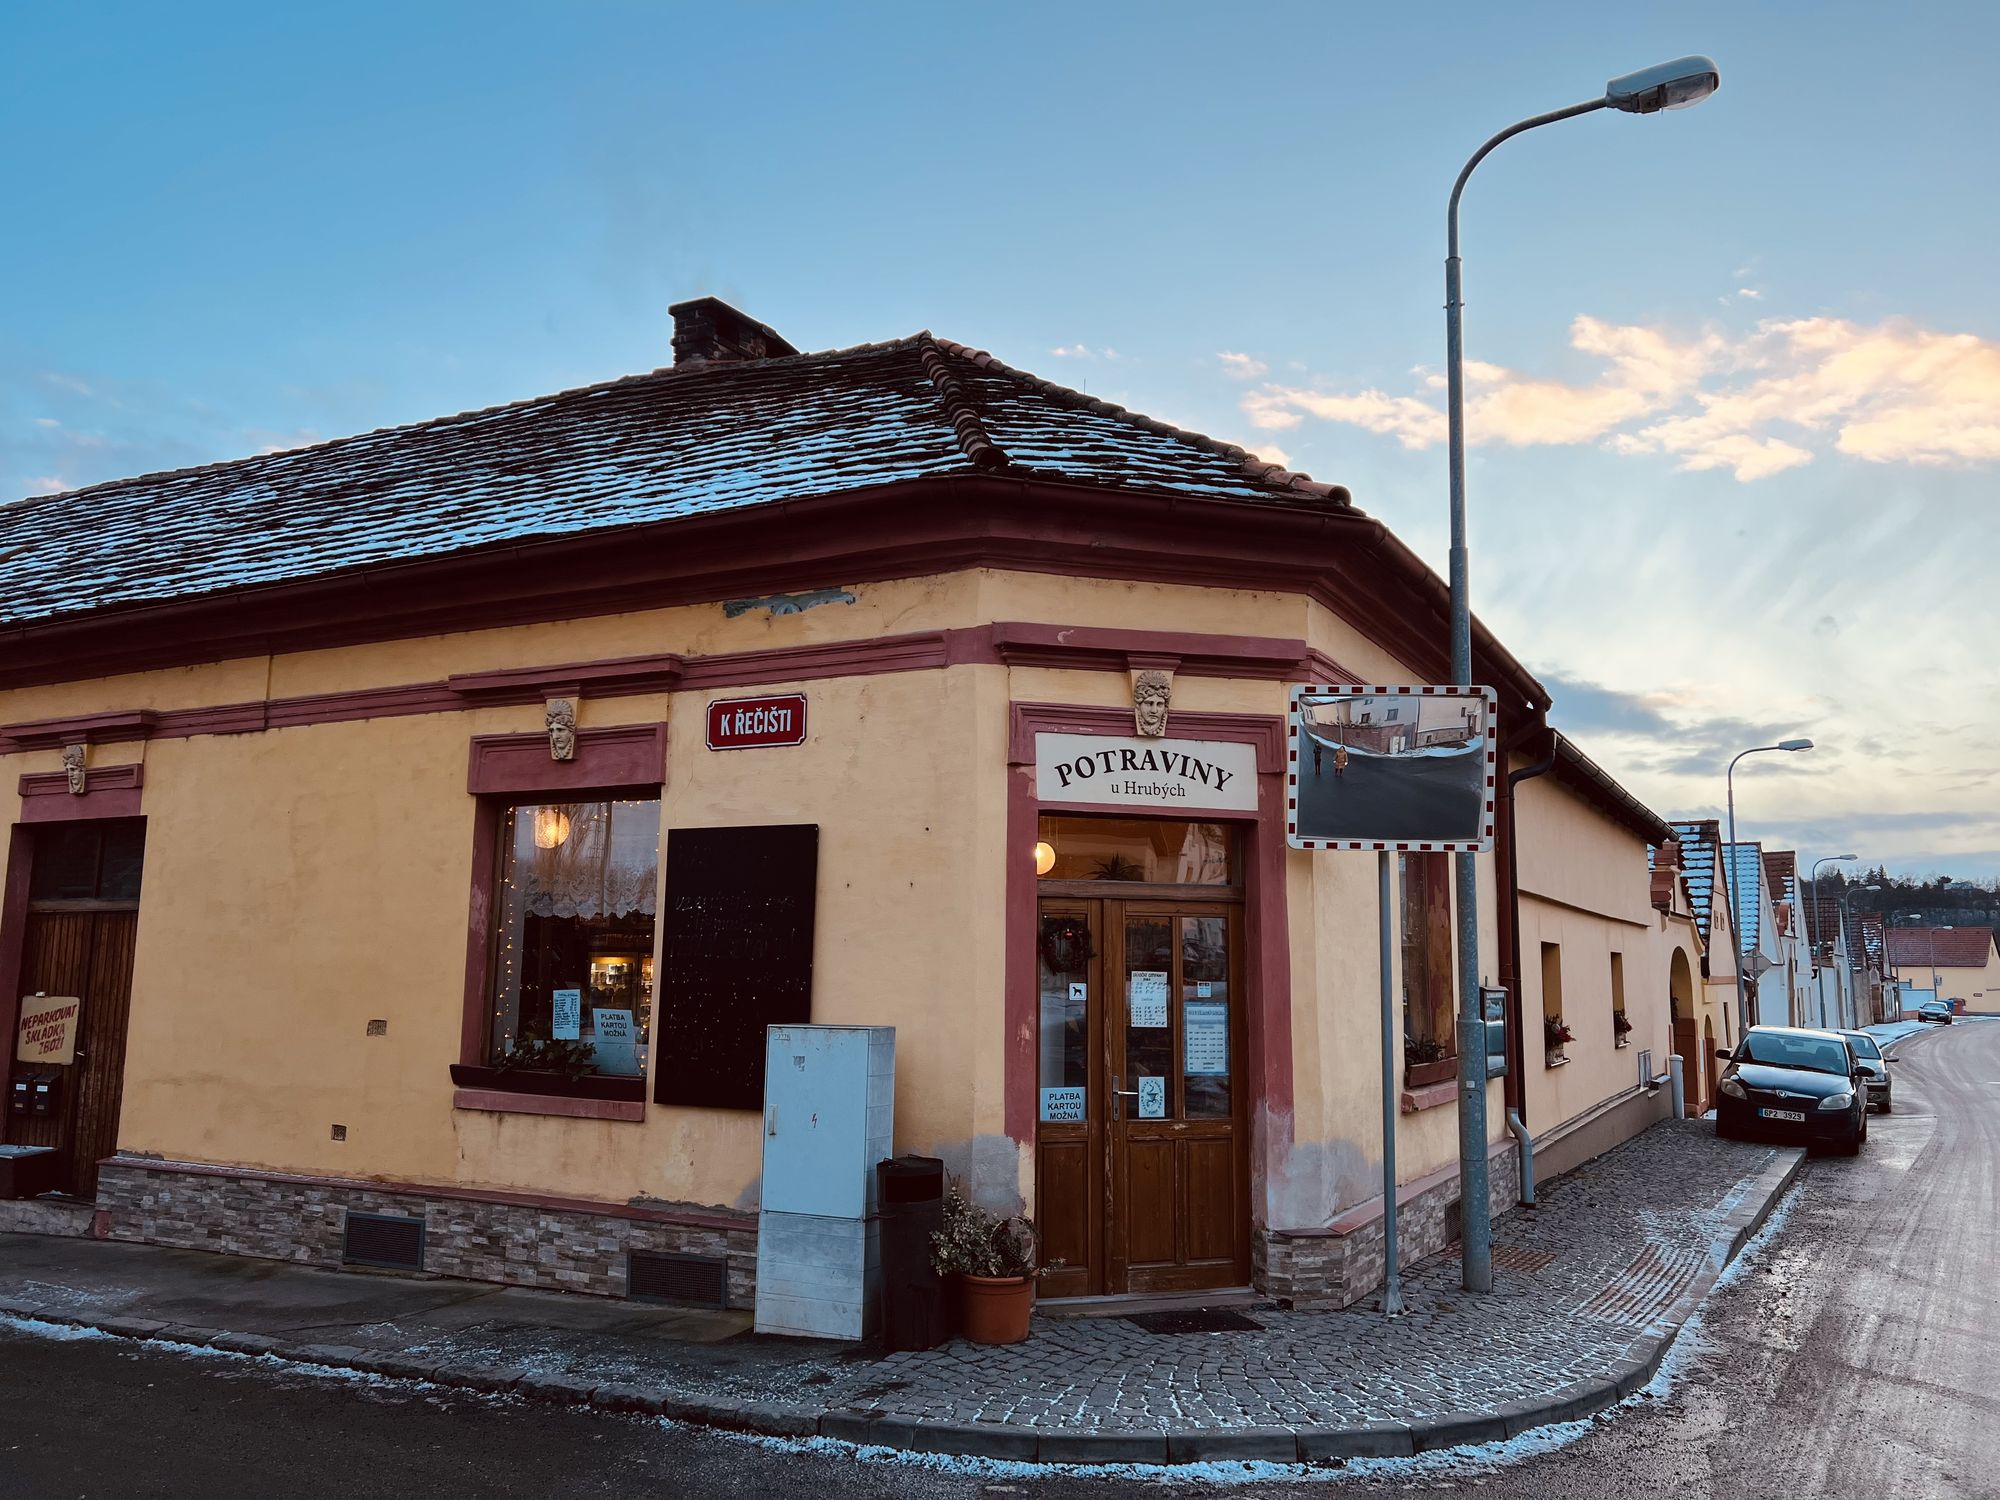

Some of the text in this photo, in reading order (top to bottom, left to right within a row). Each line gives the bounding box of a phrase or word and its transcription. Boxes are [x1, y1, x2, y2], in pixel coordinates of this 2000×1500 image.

[721, 706, 792, 736] K ŘEČIŠTI
[1054, 749, 1234, 792] POTRAVINY
[1111, 781, 1186, 799] u Hrubých
[21, 1004, 77, 1031] NEPARKOVAT
[600, 1013, 626, 1021] PLATBA
[603, 1029, 627, 1037] MOŽNÁ
[1049, 1093, 1081, 1101] PLATBA
[1047, 1102, 1082, 1110] KARTOU
[1049, 1111, 1079, 1120] MOŽNÁ
